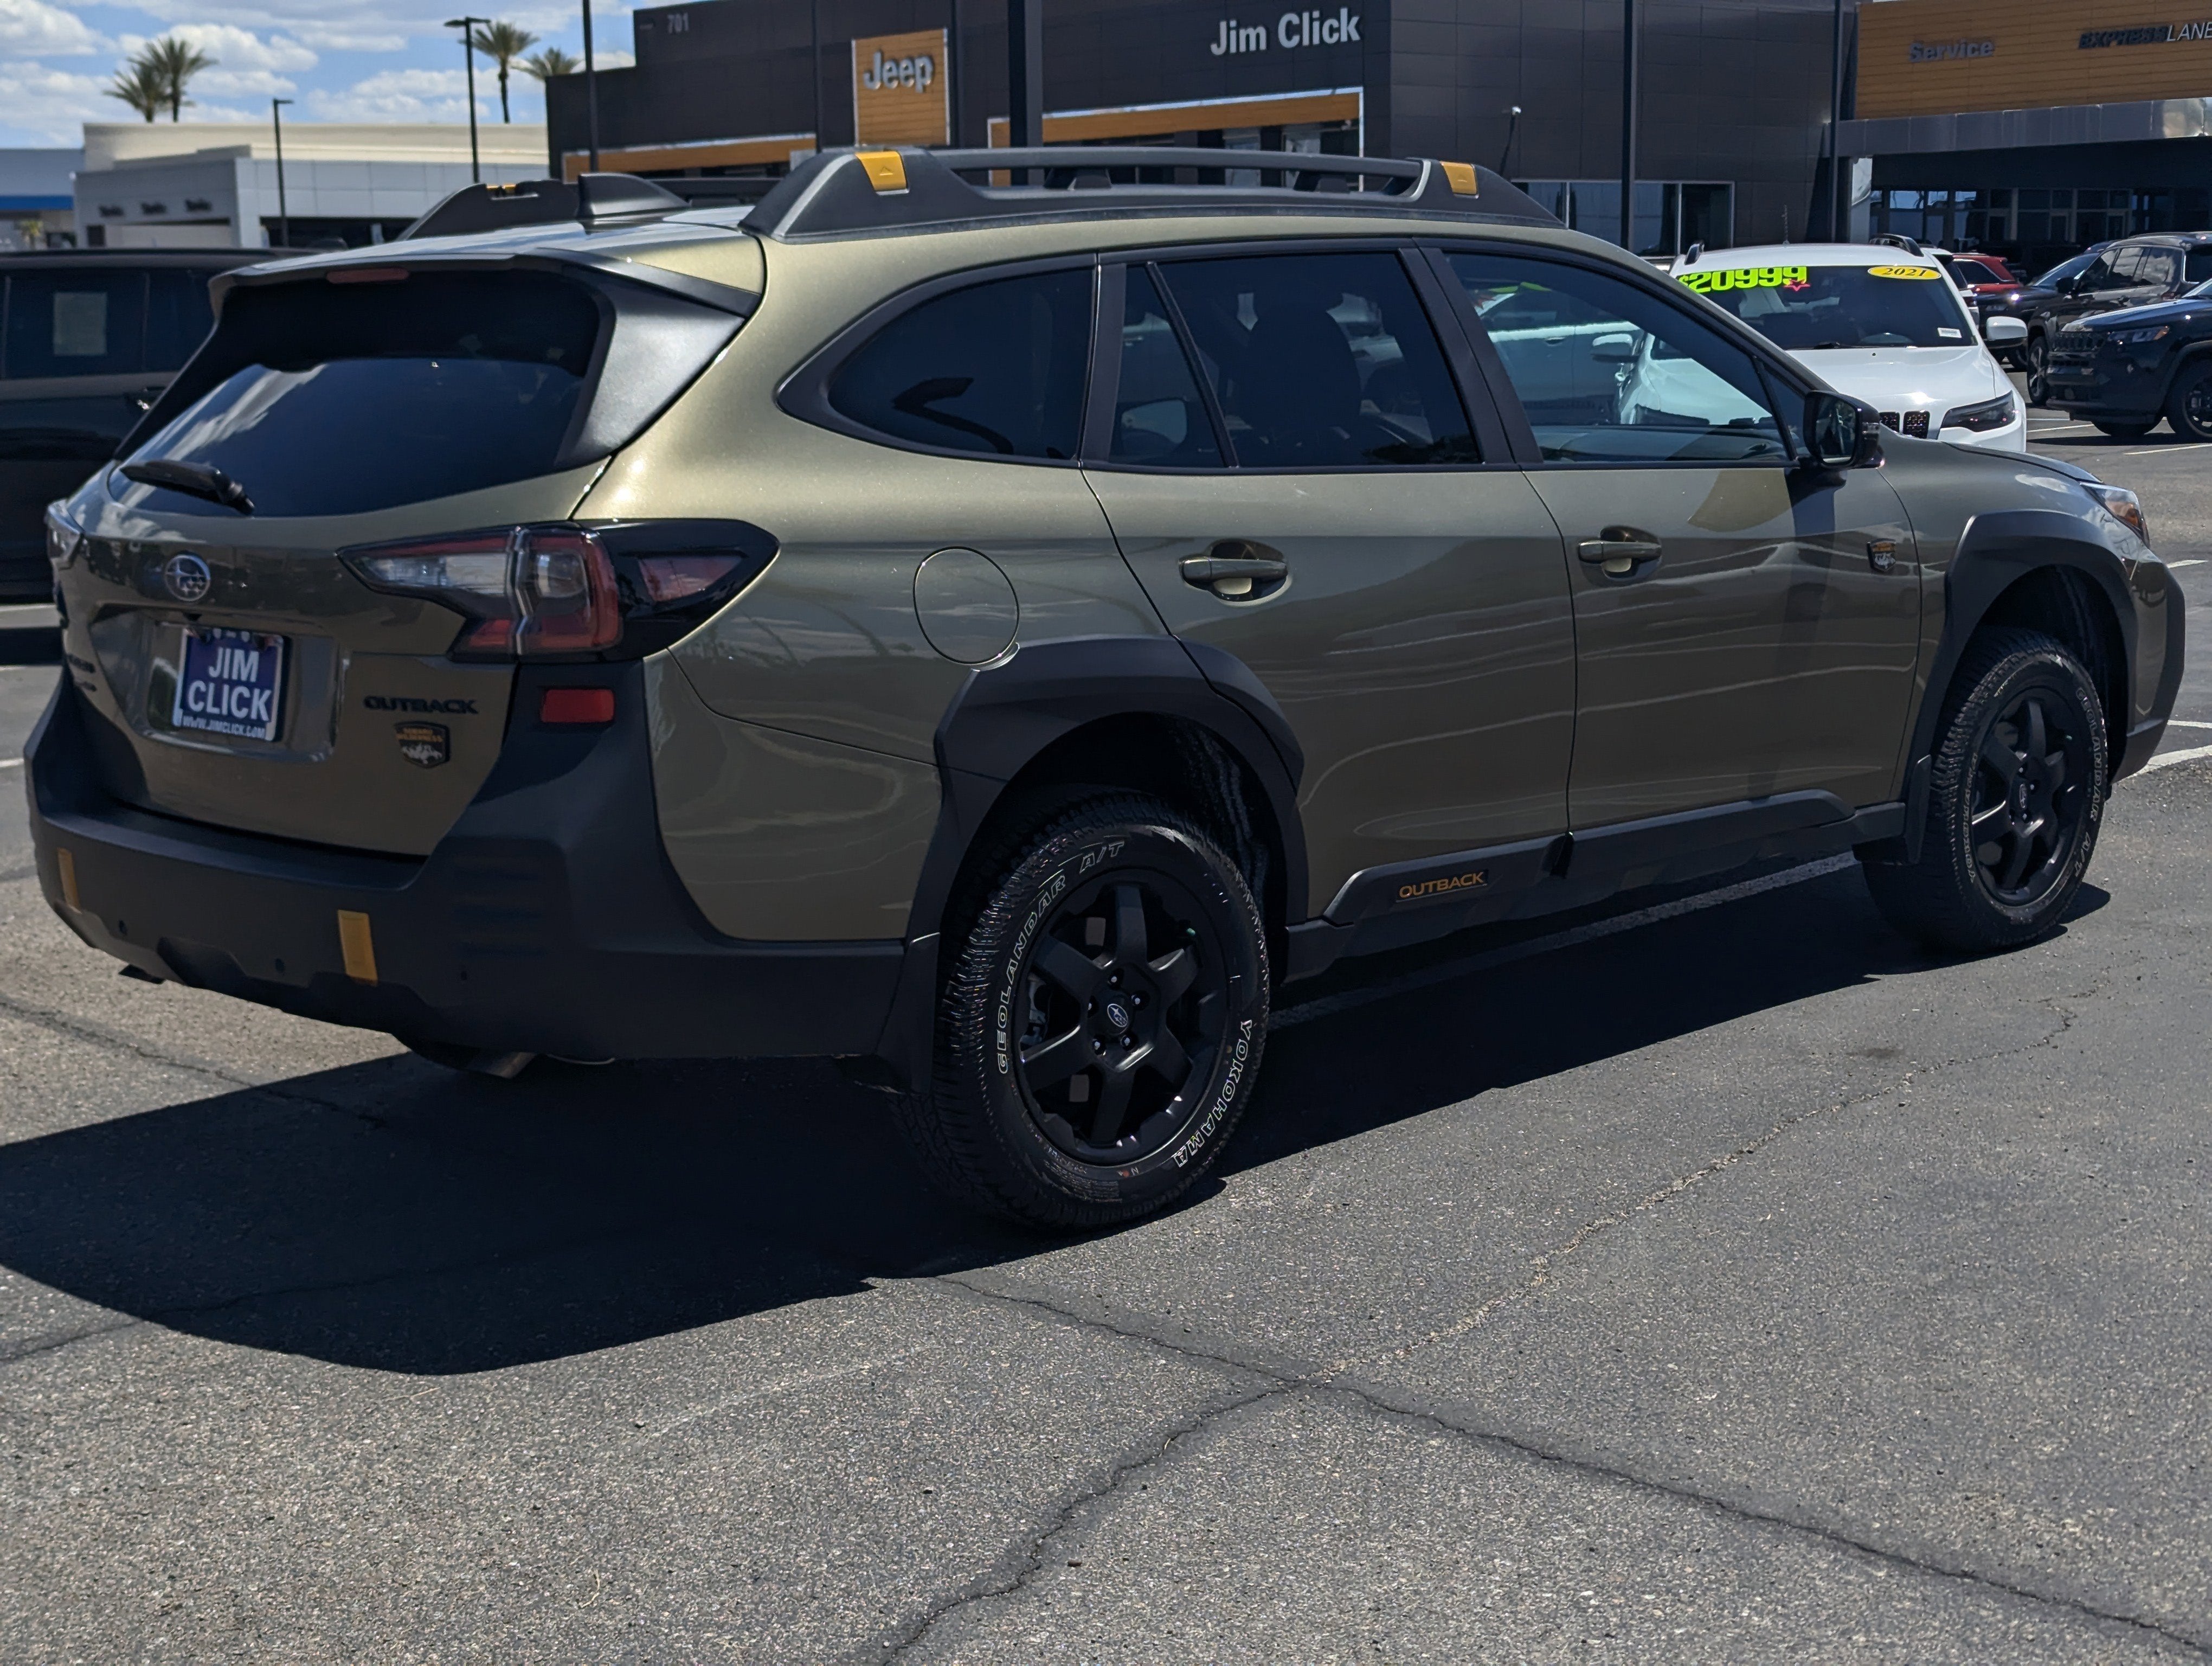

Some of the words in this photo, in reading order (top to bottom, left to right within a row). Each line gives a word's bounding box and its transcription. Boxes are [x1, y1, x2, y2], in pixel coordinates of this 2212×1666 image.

[667, 12, 689, 34] 701
[1210, 20, 1266, 55] Jim
[1278, 7, 1360, 48] Click
[1909, 39, 1994, 63] Service
[863, 51, 933, 93] Jeep
[1882, 267, 1927, 277] 2021
[208, 646, 259, 683] JIM
[187, 680, 272, 721] CLICK
[363, 696, 479, 715] OUTBACK
[1399, 872, 1484, 899] OUTBACK
[997, 875, 1065, 1074] GEOLANDAR
[1079, 840, 1126, 874] A/T
[1167, 1019, 1253, 1168] YOKOHAMA
